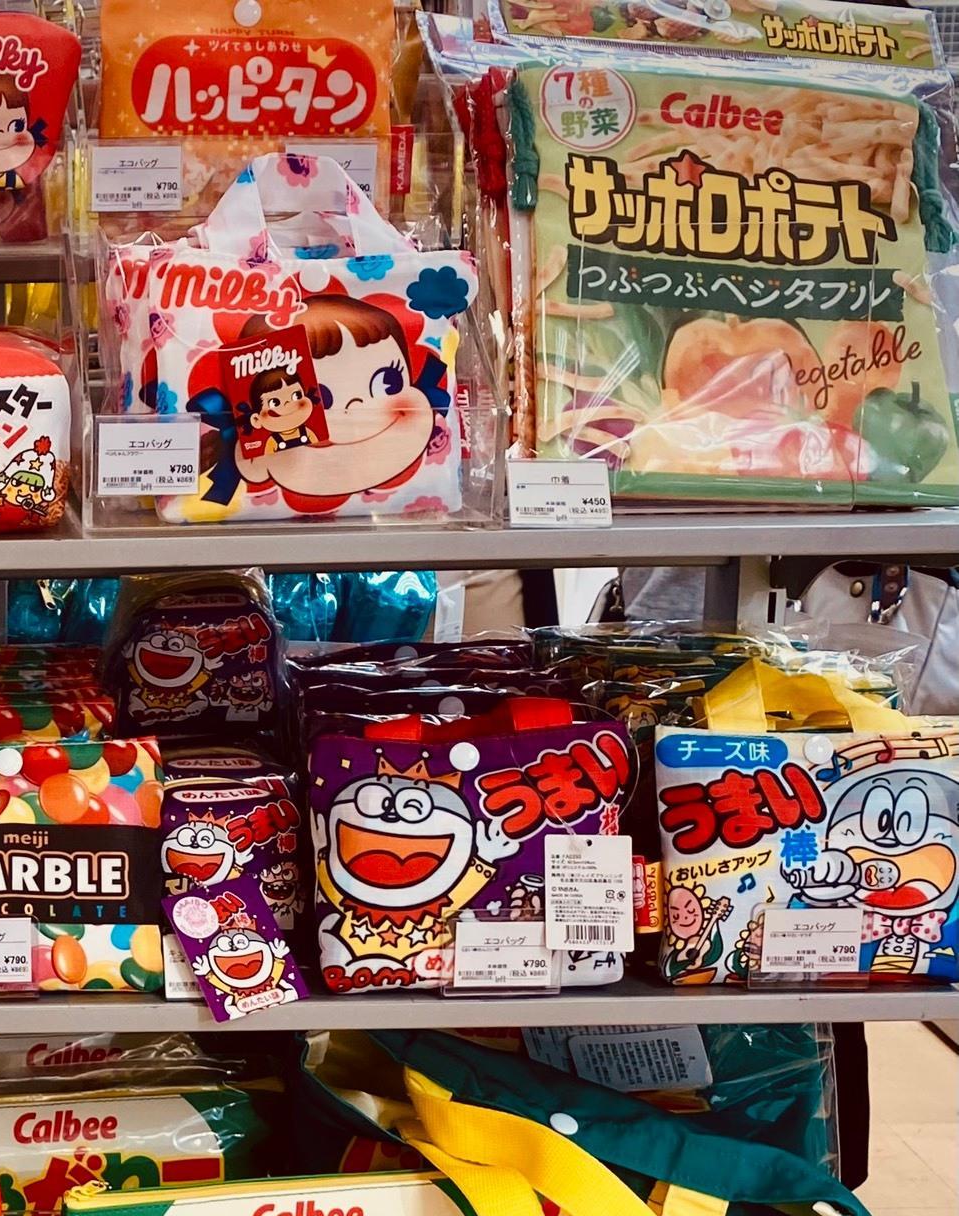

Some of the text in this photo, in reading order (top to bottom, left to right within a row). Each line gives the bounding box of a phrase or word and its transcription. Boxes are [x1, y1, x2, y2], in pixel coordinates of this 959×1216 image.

[209, 39, 302, 52] ツイてるしあわせ
[763, 15, 898, 59] サッポロポテト
[141, 56, 368, 125] ハッピーターン
[553, 71, 612, 100] 7種
[561, 108, 620, 137] 野菜
[660, 93, 784, 135] Calbee
[119, 158, 159, 168] エコバッグ
[397, 131, 407, 191] KAMEDA
[569, 156, 893, 263] サッポロポテト
[157, 258, 307, 330] Milky
[579, 263, 891, 309] つぶつぶベジタブル
[230, 345, 303, 377] Milky
[789, 326, 922, 409] egetable
[129, 438, 173, 448] エコバッグ
[170, 465, 193, 473] ¥790
[582, 498, 606, 506] ¥450
[677, 741, 770, 764] チーズ味
[182, 787, 263, 801] めんたい味
[476, 731, 629, 839] うまい
[662, 765, 824, 852] うまい
[3, 832, 50, 848] meiji
[780, 828, 818, 868] 棒
[676, 850, 772, 883] おいしさアップ
[209, 892, 245, 924] まい
[484, 936, 527, 946] エコバッグ
[793, 922, 836, 931] エコバッグ
[4, 955, 27, 965] ¥790
[523, 959, 547, 968] ¥790
[832, 945, 856, 954] ¥790
[14, 1110, 118, 1144] Calbee
